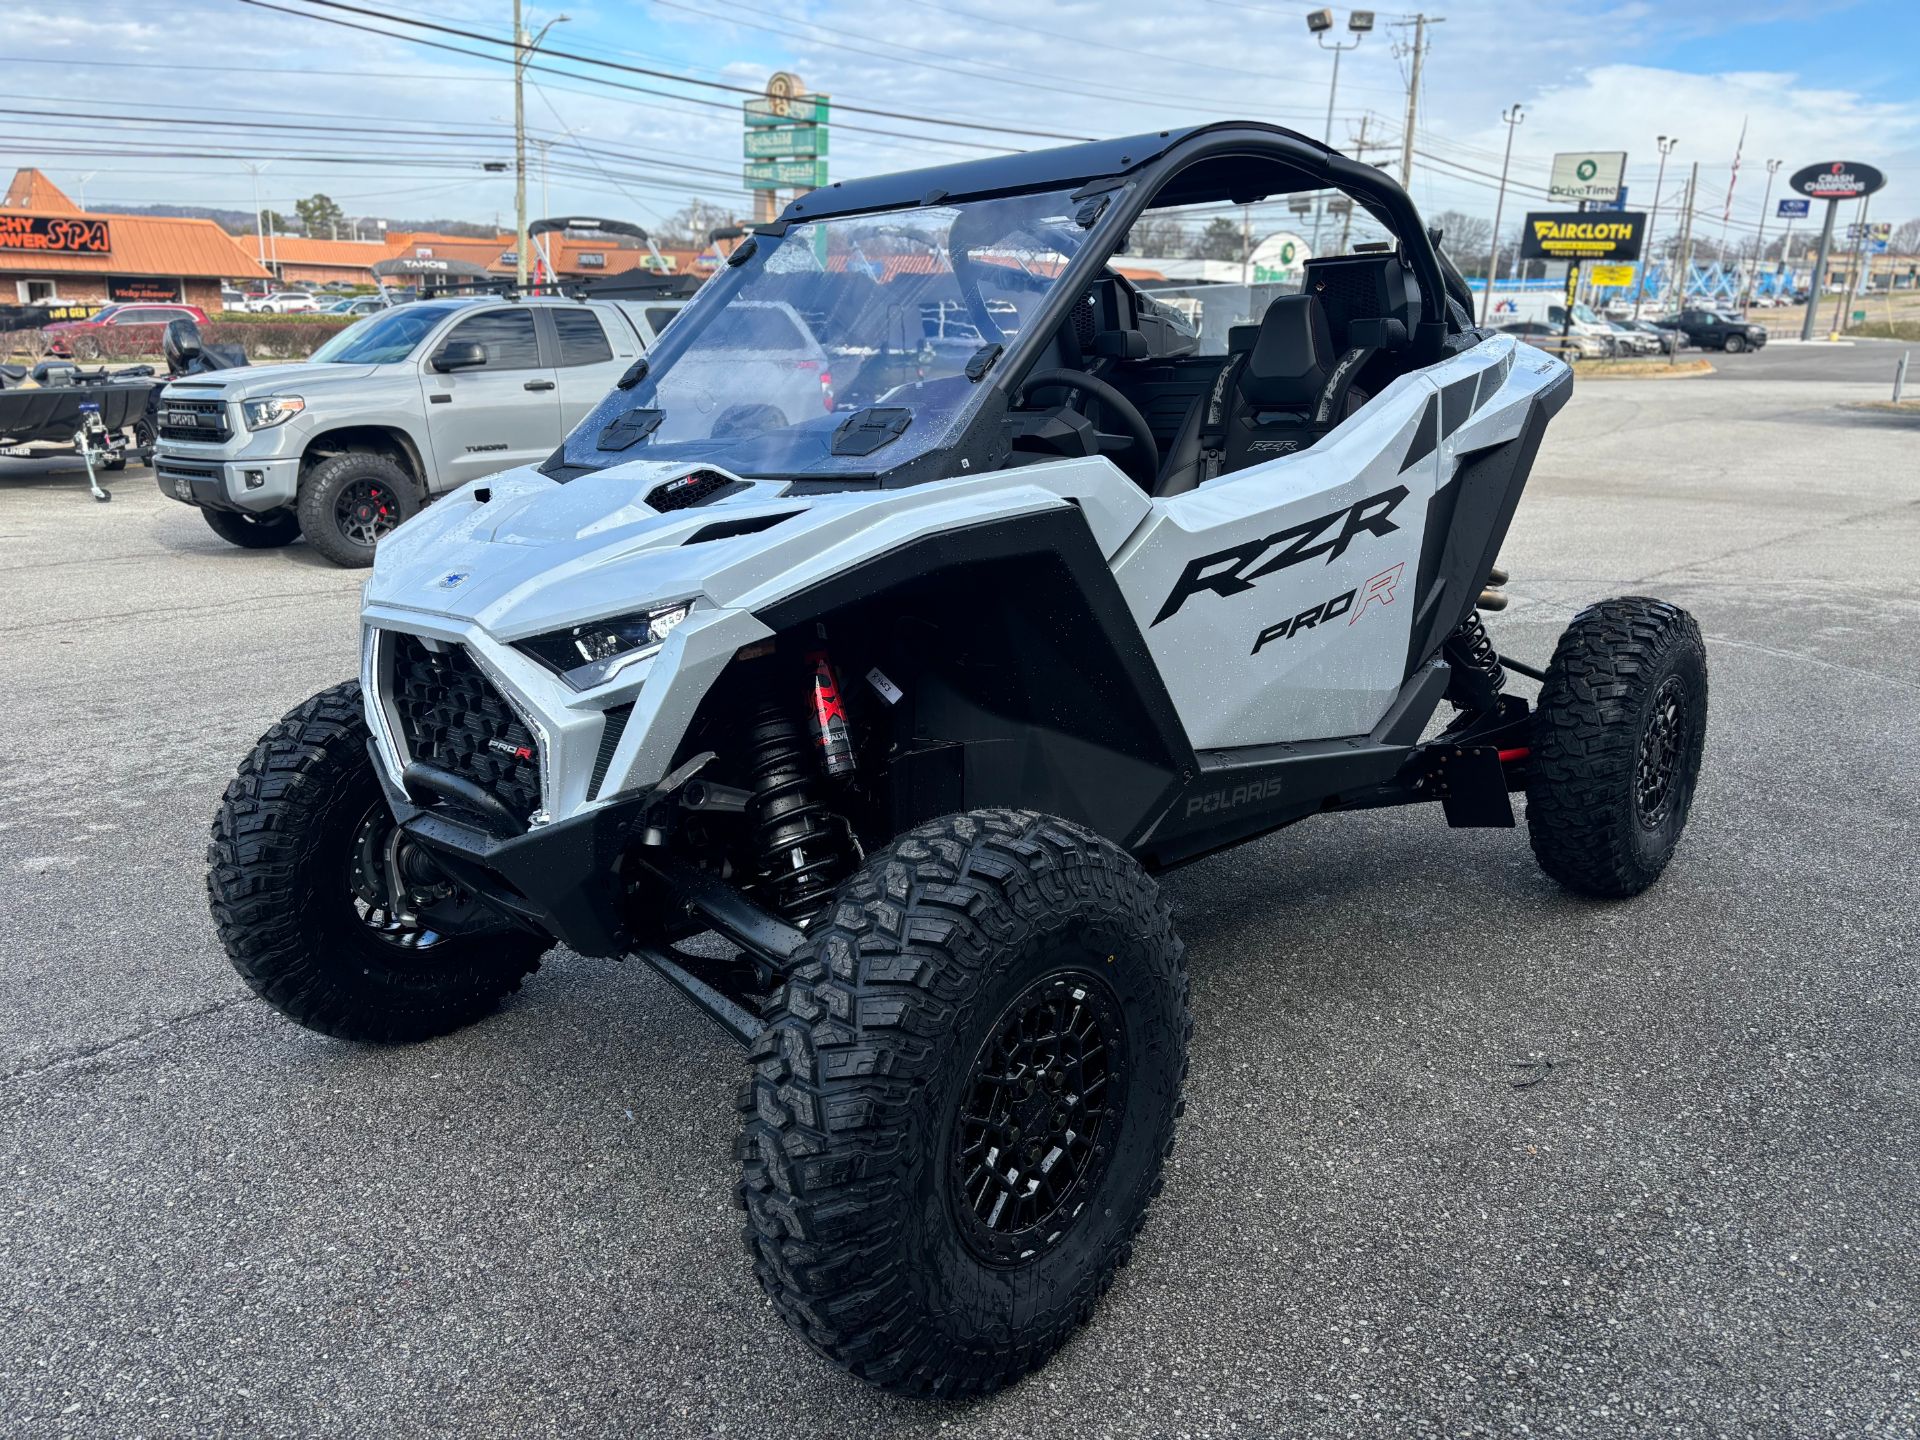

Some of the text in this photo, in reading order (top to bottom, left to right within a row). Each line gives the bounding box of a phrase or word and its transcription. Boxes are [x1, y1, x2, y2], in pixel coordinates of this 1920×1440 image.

[1818, 174, 1855, 182] CRASH
[1551, 185, 1616, 195] DriveTime
[1804, 181, 1865, 191] CHAMPIONS
[47, 220, 109, 251] SPA
[1533, 220, 1633, 240] FAIRCLOTH
[403, 260, 448, 270] TAHOE
[169, 413, 197, 426] TOYOTA
[465, 443, 508, 452] TUNDRA
[1149, 484, 1410, 628] RZR
[1186, 777, 1282, 817] POLARIS
